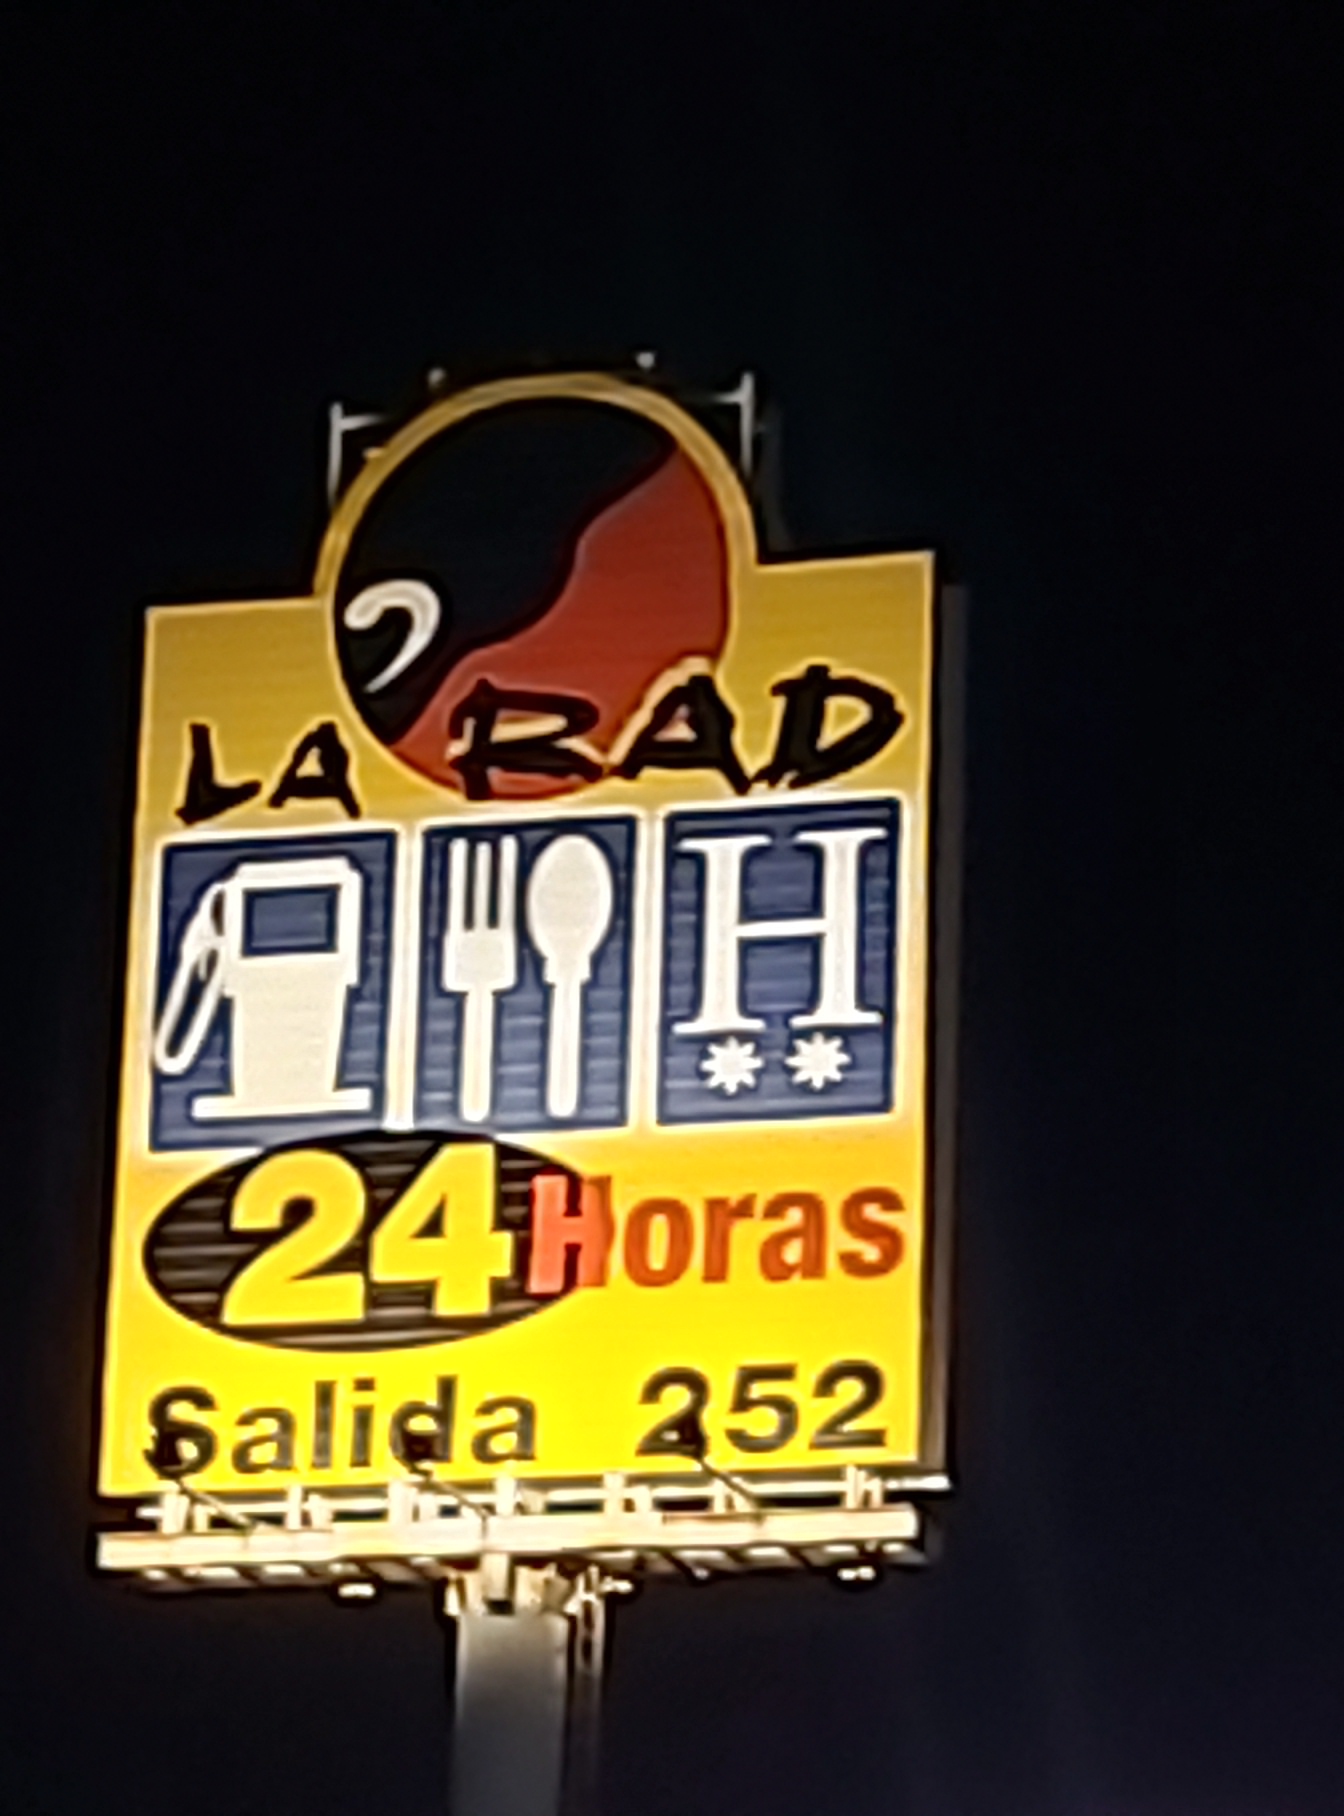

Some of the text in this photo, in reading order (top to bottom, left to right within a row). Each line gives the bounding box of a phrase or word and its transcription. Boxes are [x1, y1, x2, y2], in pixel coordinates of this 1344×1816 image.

[175, 722, 361, 826] LA
[671, 827, 888, 1034] H
[221, 1142, 908, 1326] 24 Horas
[143, 1358, 890, 1480] Salida 252
